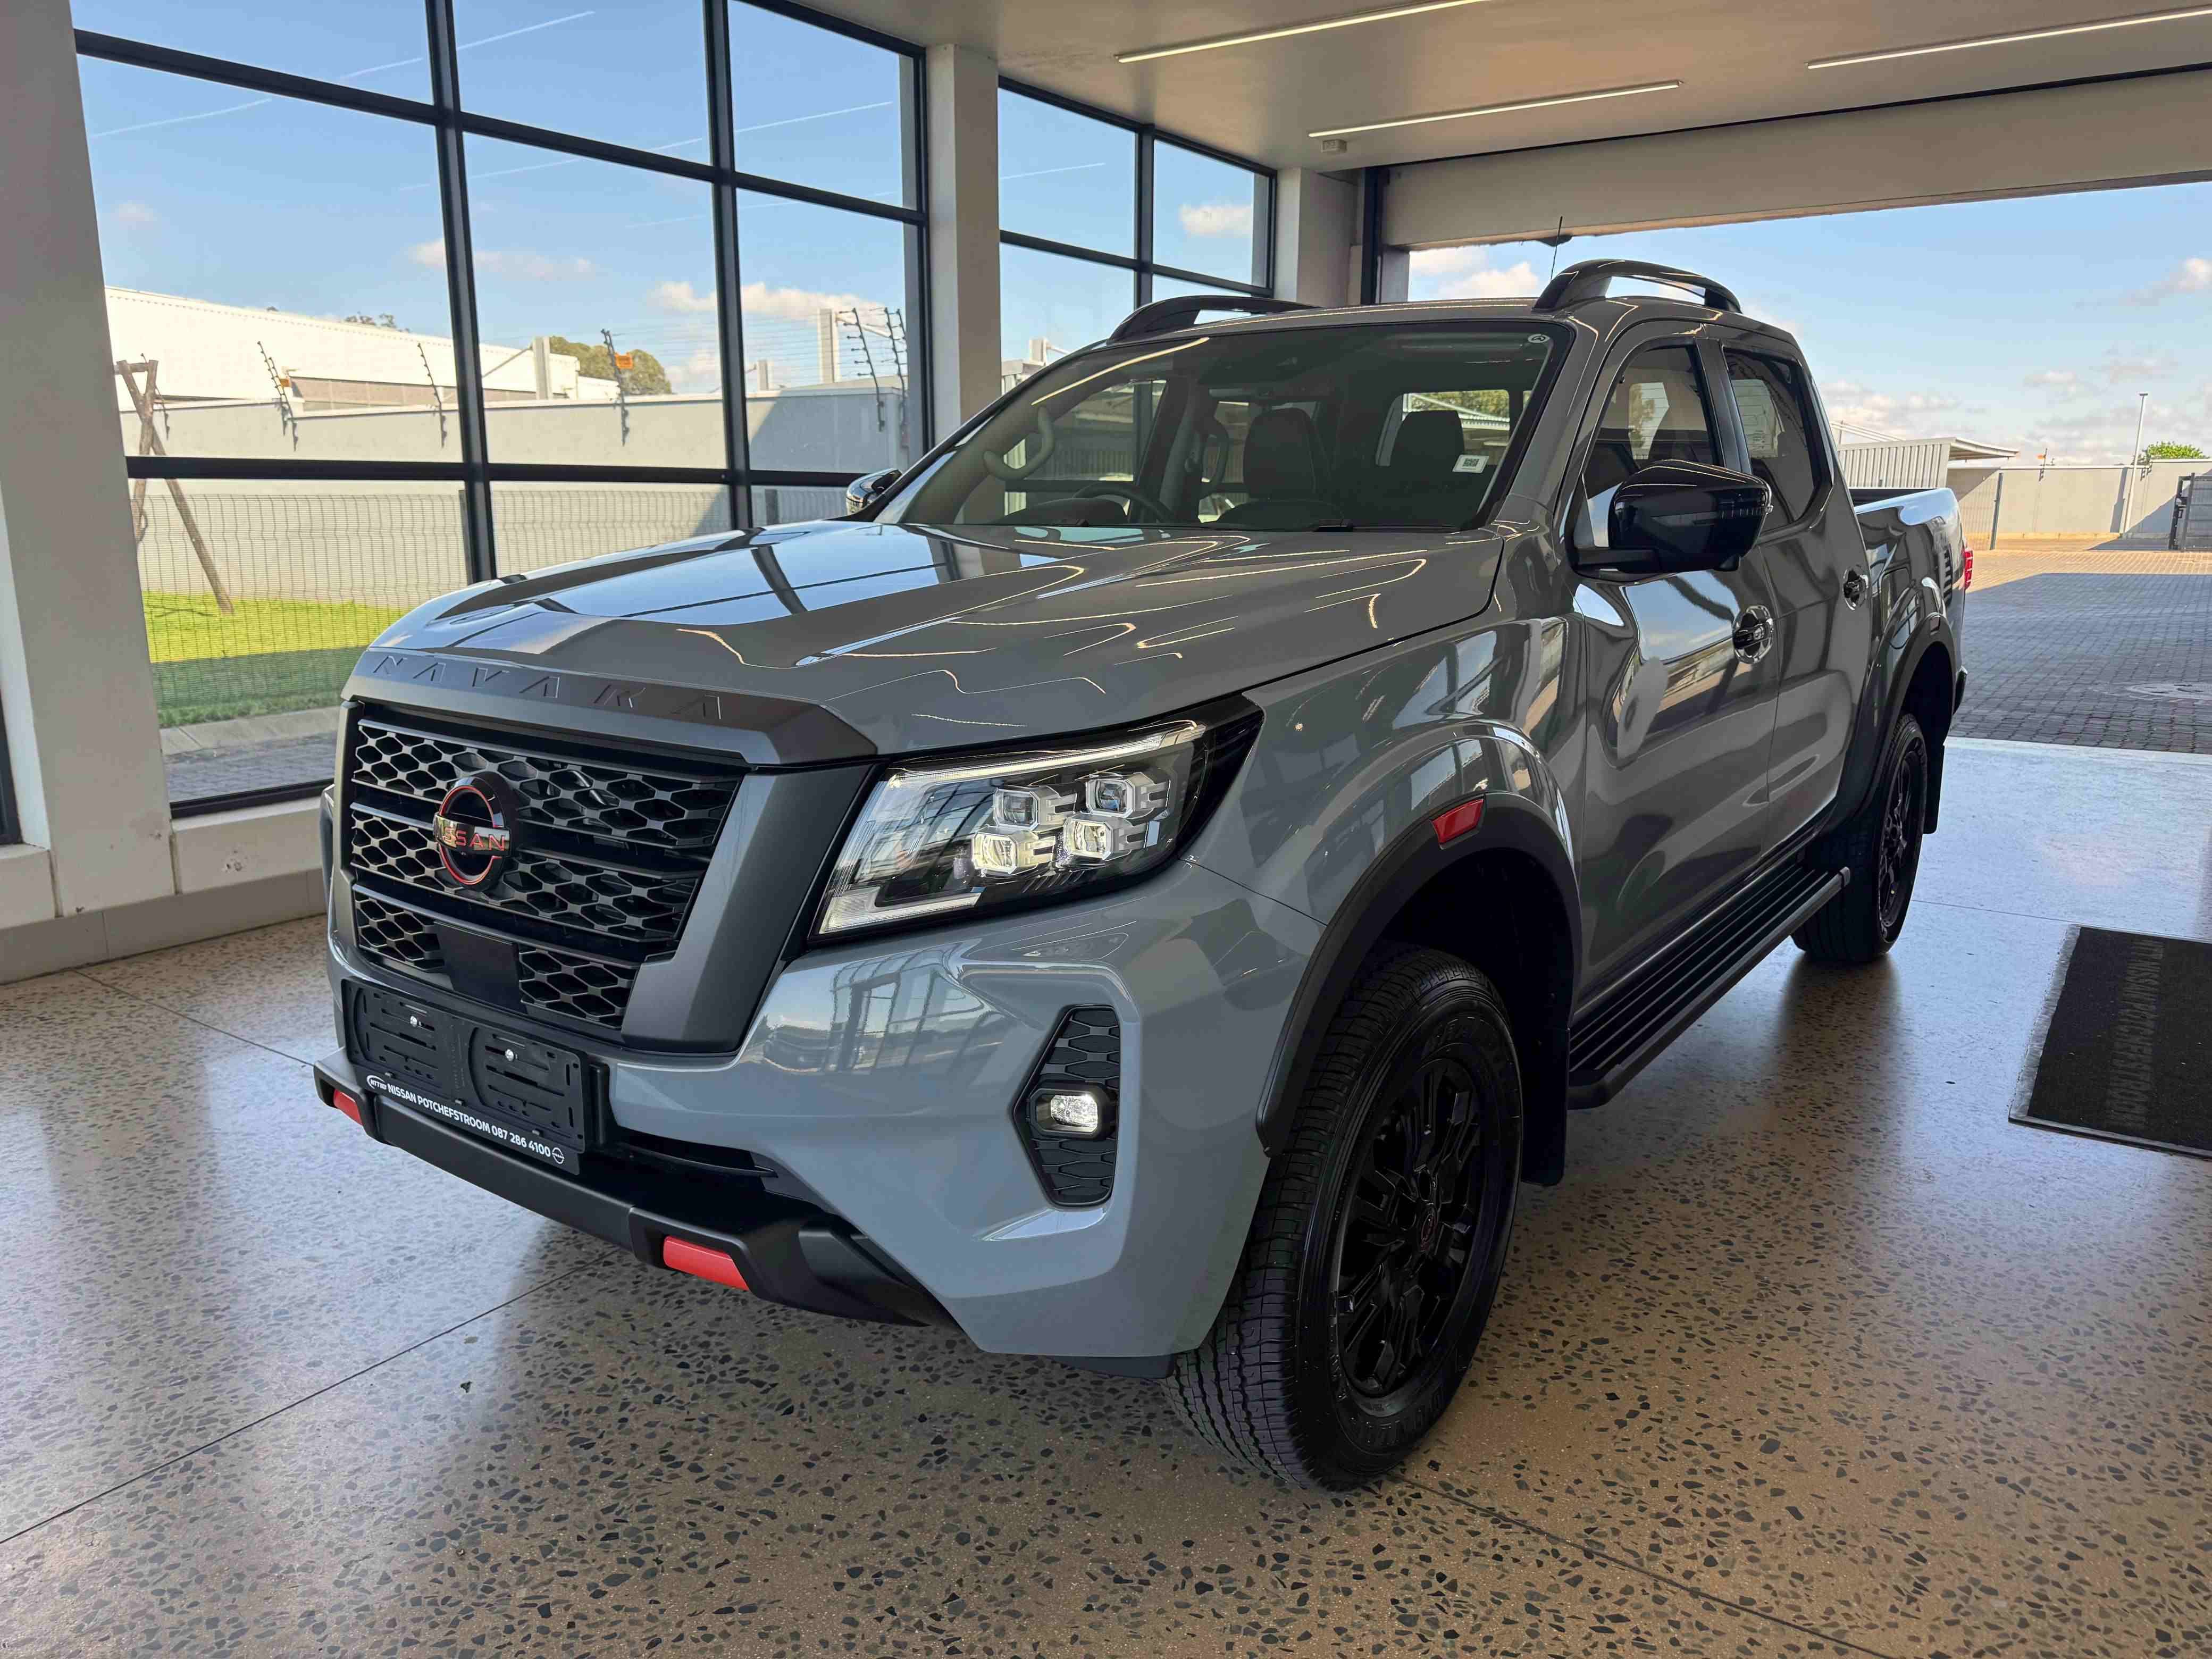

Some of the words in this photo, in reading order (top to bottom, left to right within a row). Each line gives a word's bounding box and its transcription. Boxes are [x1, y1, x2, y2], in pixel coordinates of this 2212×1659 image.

[373, 655, 722, 719] NAVARA
[436, 820, 506, 851] SSAN
[387, 1083, 417, 1103] NISSAN
[417, 1095, 490, 1134] POTCHEFSTROOM
[491, 1127, 508, 1139] 087
[510, 1134, 527, 1147] 286
[529, 1141, 551, 1157] 4100
